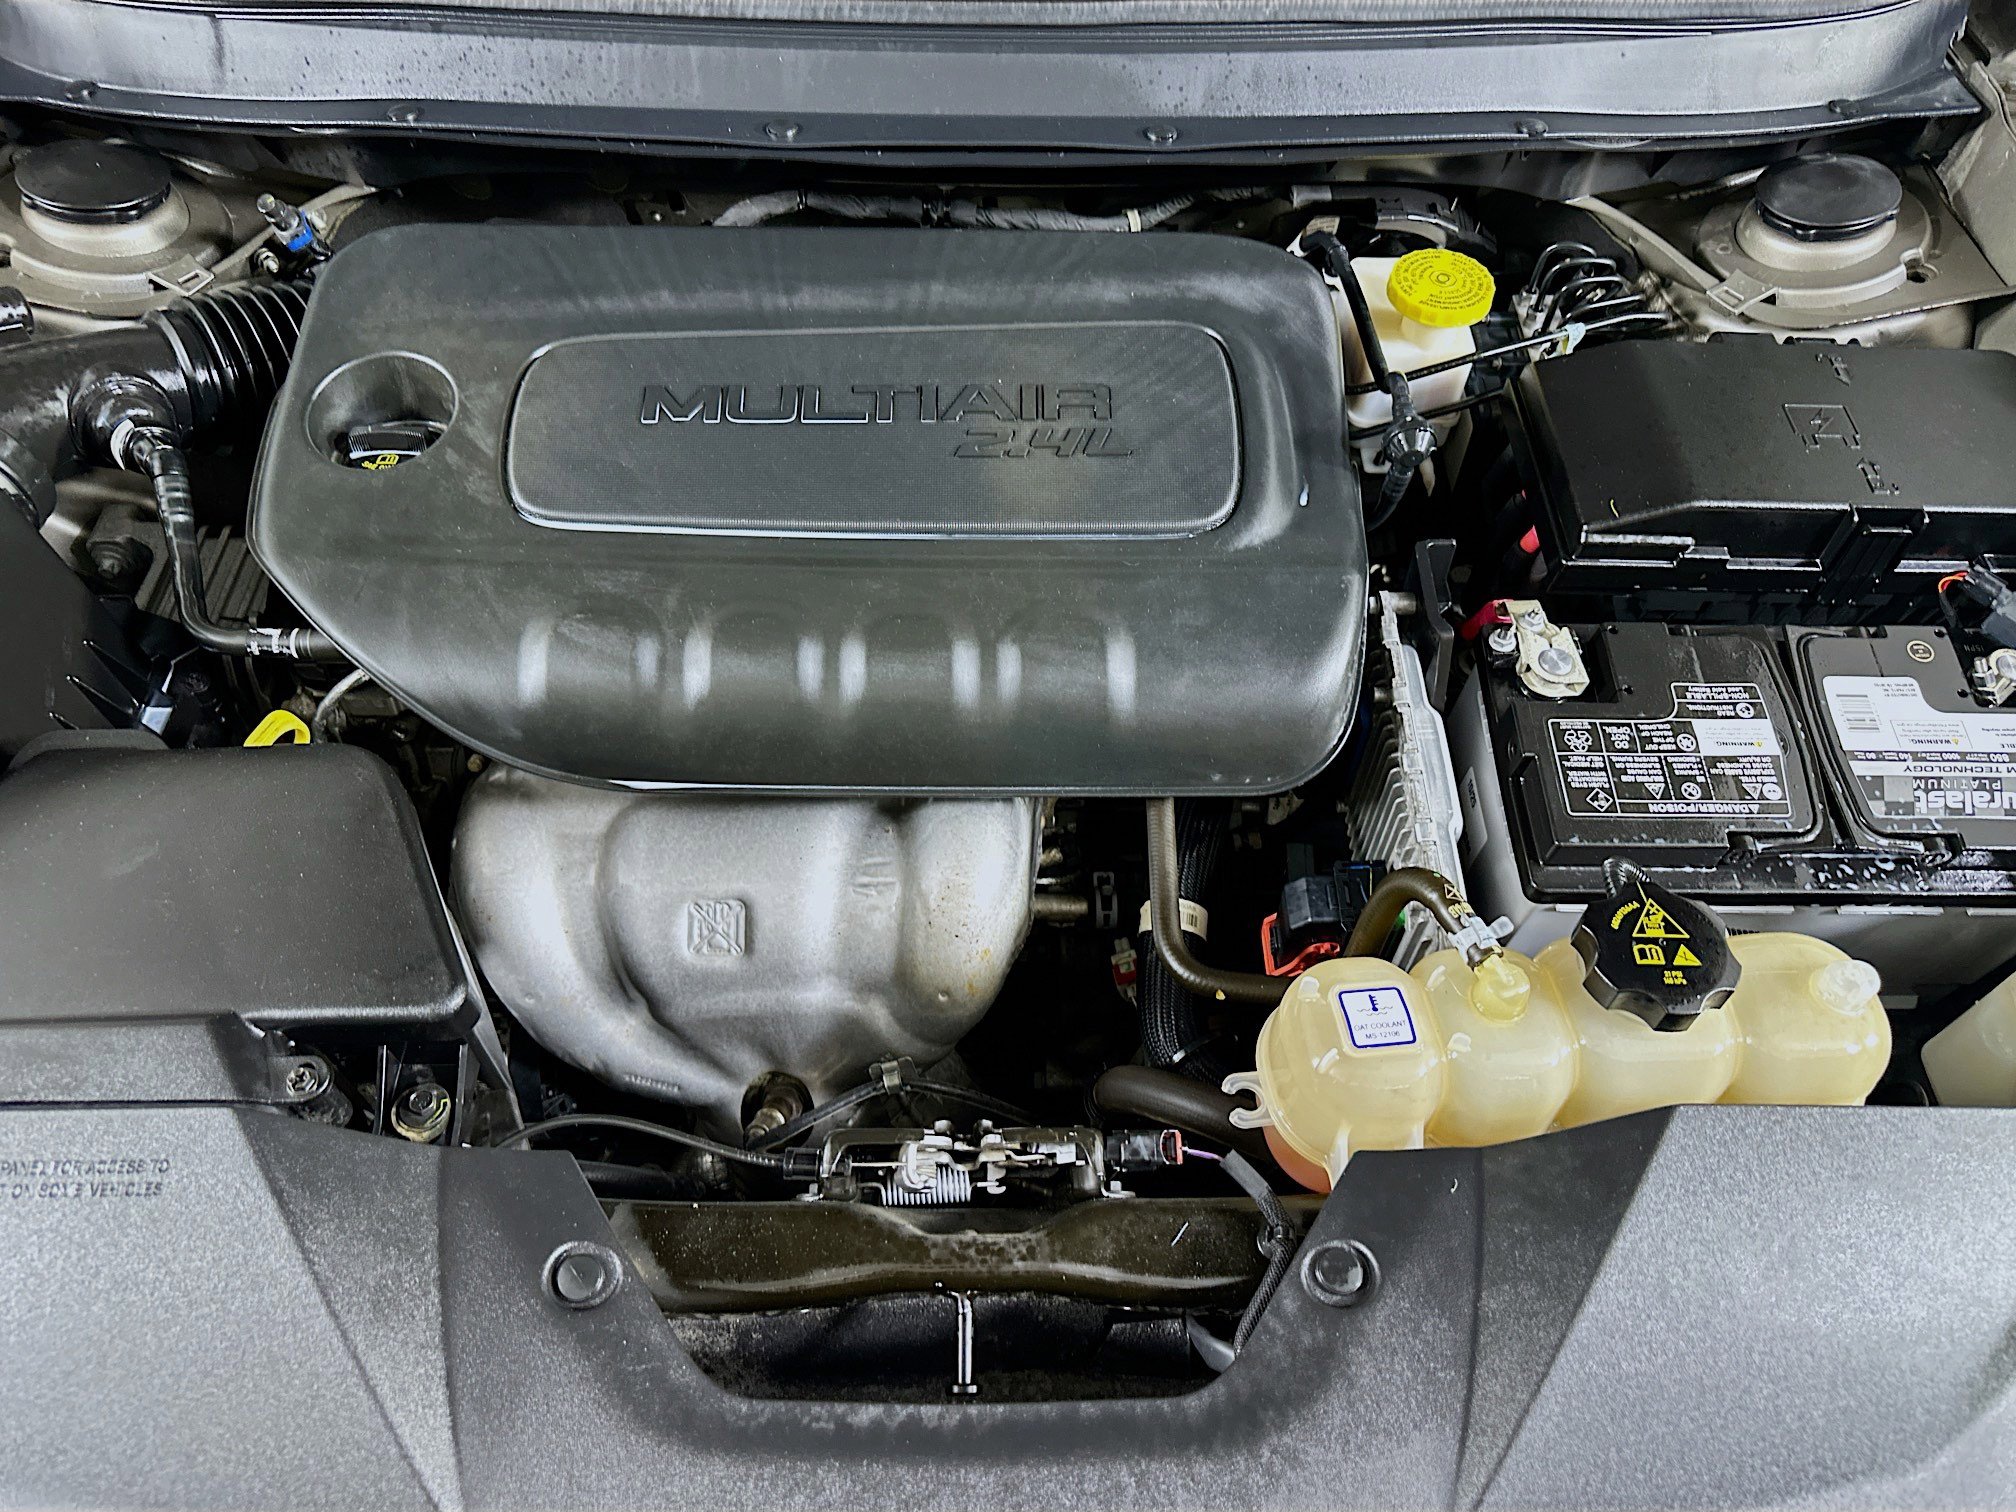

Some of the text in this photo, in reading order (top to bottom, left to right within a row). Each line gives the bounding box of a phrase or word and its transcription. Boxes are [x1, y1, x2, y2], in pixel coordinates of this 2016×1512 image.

[642, 384, 1112, 424] MULTIAIR
[953, 427, 1134, 459] 2.4L
[1611, 733, 1630, 741] NOT
[1614, 740, 1630, 750] DO
[1903, 765, 2002, 774] TECHNOLOGY
[1912, 779, 2001, 790] PLATINUM
[1647, 803, 1750, 813] DANGER/POISON
[1370, 1020, 1406, 1030] COOLANT
[150, 1158, 169, 1174] TO
[90, 1182, 164, 1198] VEHICLES
